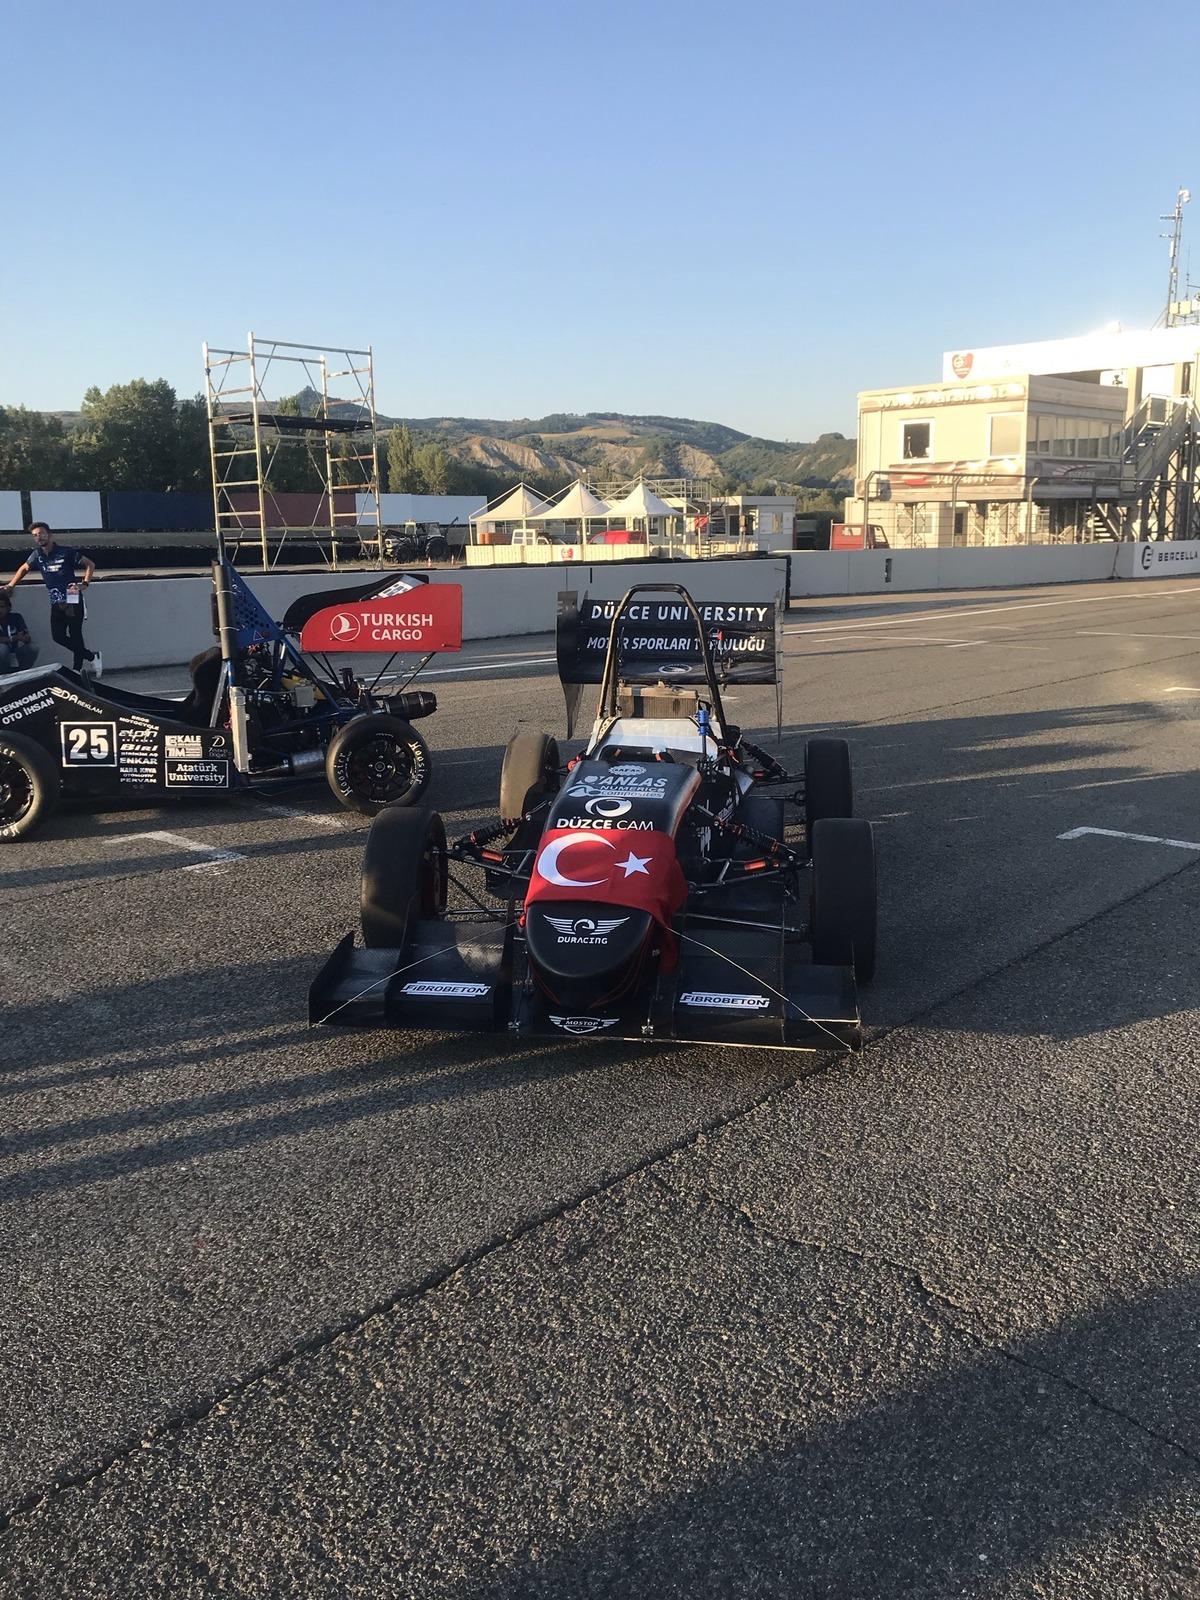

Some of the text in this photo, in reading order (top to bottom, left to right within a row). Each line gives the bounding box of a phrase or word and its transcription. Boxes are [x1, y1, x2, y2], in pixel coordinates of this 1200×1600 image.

[1158, 551, 1198, 561] BERCELLA
[361, 613, 433, 627] TURKISH
[372, 629, 423, 641] CARGO
[632, 637, 691, 650] SPORLARI
[2, 711, 23, 725] OTO
[68, 728, 109, 760] 25
[178, 735, 202, 743] KALE
[119, 757, 158, 765] ENKAR
[176, 763, 218, 772] Atatürk
[168, 772, 225, 785] University
[598, 776, 668, 787] ANLAS
[556, 816, 654, 831] DÜZCE CAM
[557, 936, 609, 945] DURACING
